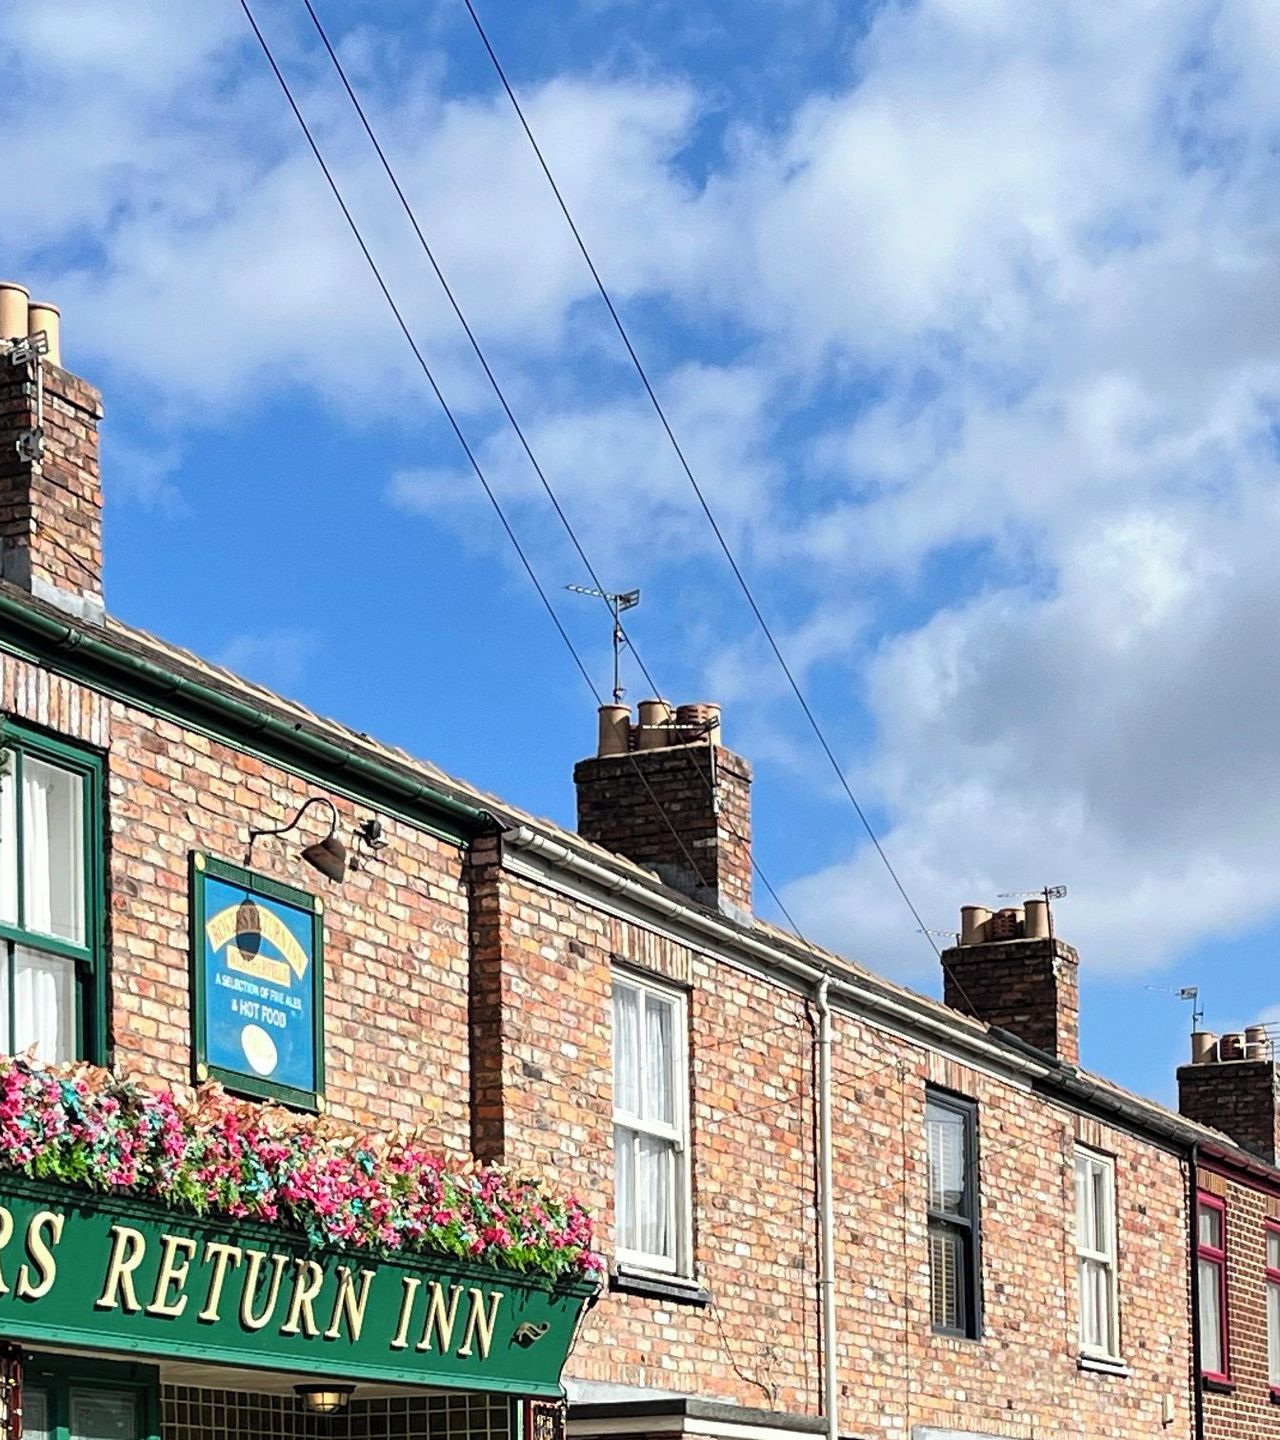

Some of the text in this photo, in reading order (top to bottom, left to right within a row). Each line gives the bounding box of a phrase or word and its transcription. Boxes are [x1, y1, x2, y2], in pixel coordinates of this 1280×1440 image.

[240, 999, 261, 1020] HOT
[261, 1005, 288, 1029] FOOD
[94, 1225, 376, 1342] RETURN
[390, 1275, 505, 1360] INN
